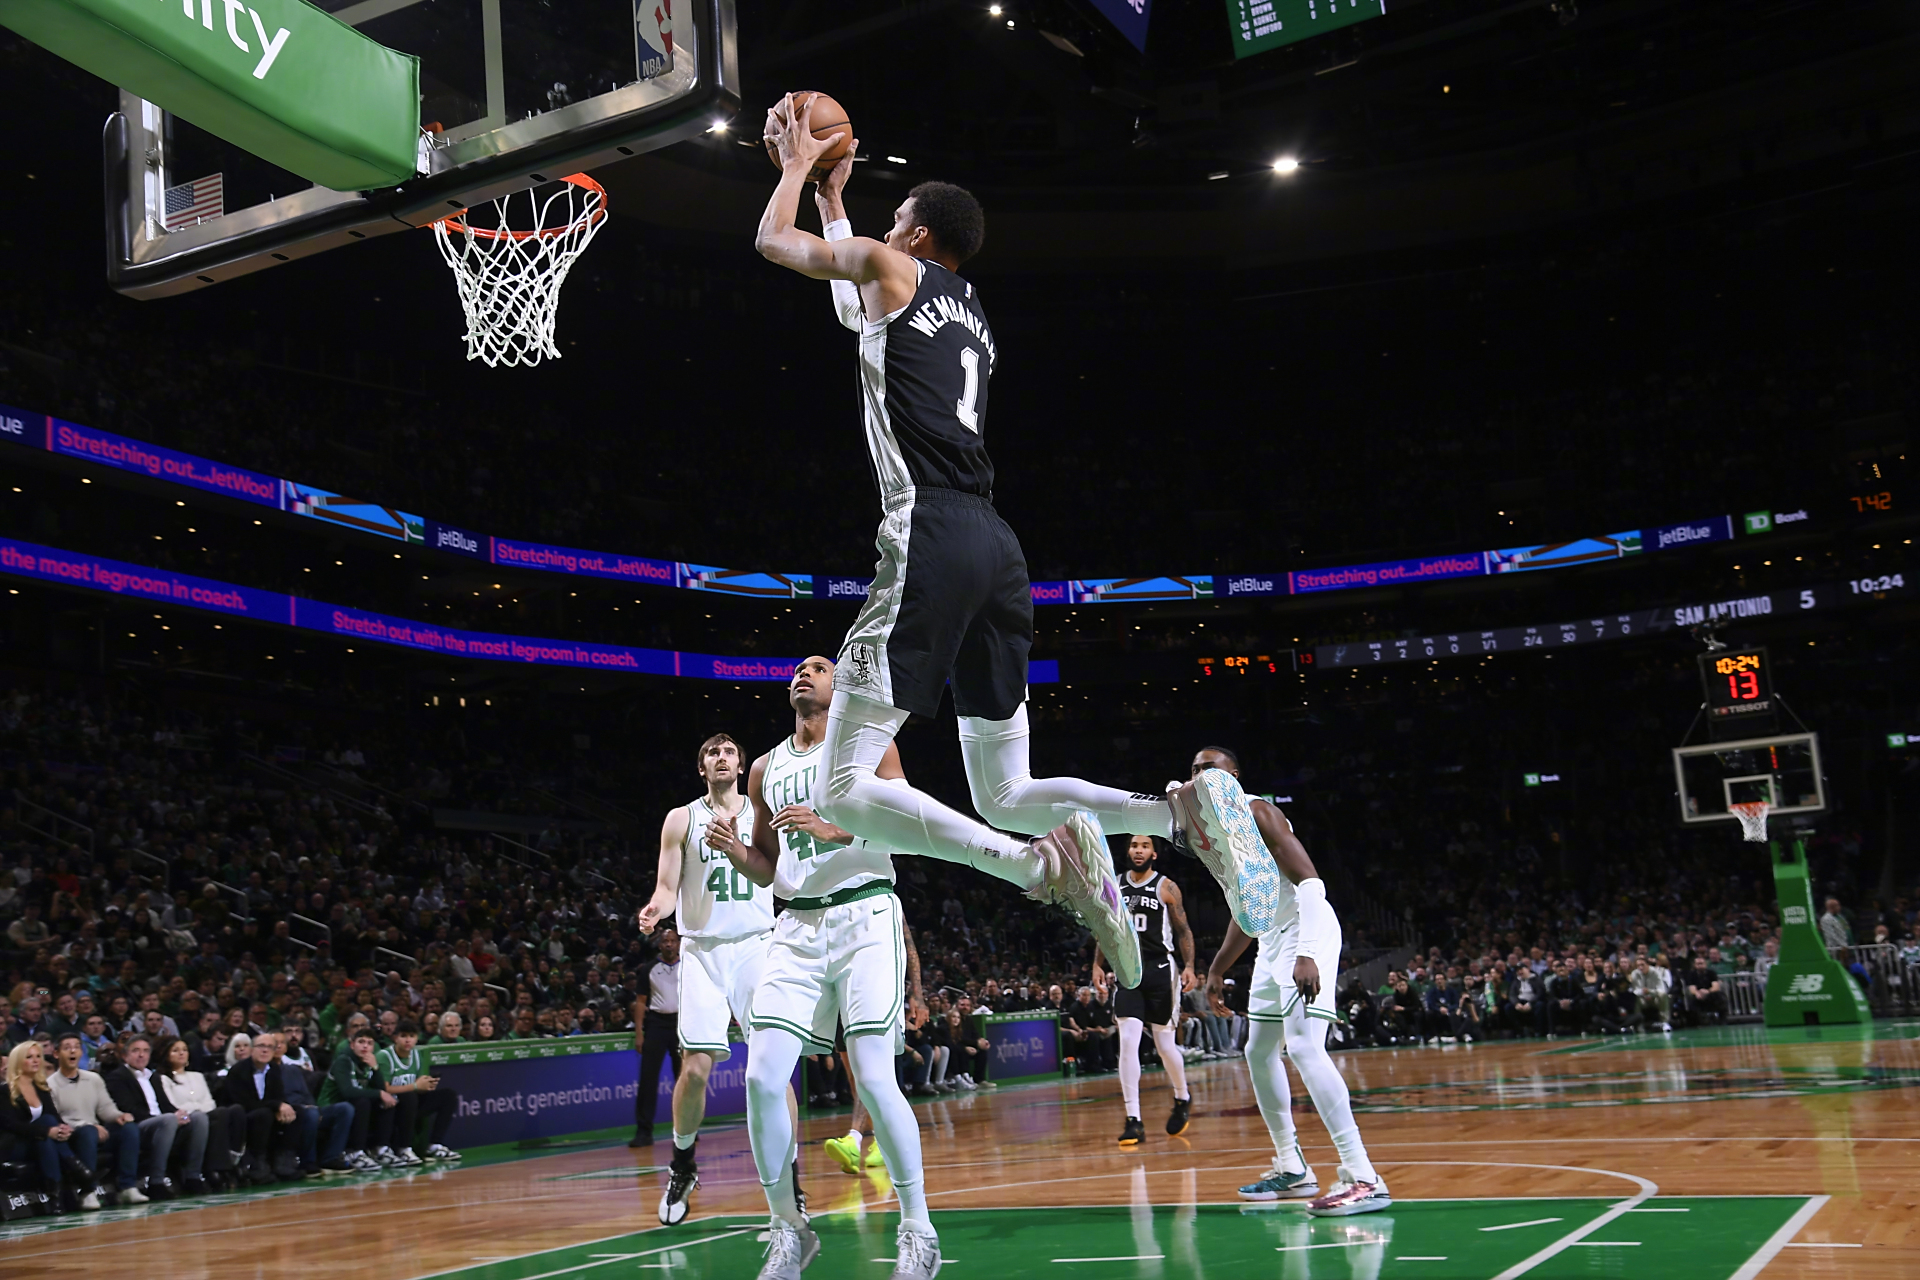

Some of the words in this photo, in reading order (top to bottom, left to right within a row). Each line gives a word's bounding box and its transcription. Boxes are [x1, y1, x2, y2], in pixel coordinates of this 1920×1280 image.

[1251, 2, 1273, 16] BROWN
[1253, 12, 1277, 27] KORNET
[1255, 21, 1283, 37] HORFORD
[642, 56, 661, 77] NBA
[908, 295, 996, 379] WEMBANYAM
[957, 346, 980, 435] 1
[59, 426, 160, 475] Stretching
[1747, 514, 1769, 530] TD
[1775, 510, 1808, 524] Bank
[438, 527, 478, 553] jetBlue
[1658, 525, 1711, 548] jetBlue
[497, 543, 577, 571] Stretching
[0, 547, 35, 570] the
[39, 557, 91, 581] most
[93, 564, 170, 596] legroom
[172, 579, 189, 599] in
[191, 588, 247, 610] coach.
[1228, 578, 1273, 595] jetBlue
[1297, 569, 1377, 588] Stretching
[1675, 605, 1704, 626] SAN
[1709, 596, 1772, 619] ANTONIO
[1800, 590, 1816, 609] 5
[1850, 573, 1904, 594] 10:24
[333, 611, 387, 638] Stretch
[389, 626, 412, 642] out
[413, 629, 443, 648] with
[444, 634, 466, 652] the
[469, 640, 509, 656] most
[512, 641, 574, 662] legroom
[576, 647, 590, 663] in
[591, 652, 639, 667] coach.
[1373, 651, 1381, 661] 3
[1399, 649, 1407, 658] 2
[1426, 646, 1434, 656] 0
[1450, 643, 1459, 653] 0
[1524, 636, 1543, 646] 2/4
[1562, 632, 1576, 642] 50
[1596, 628, 1604, 638] 7
[1621, 624, 1630, 634] 0
[713, 660, 767, 677] Stretch
[769, 664, 795, 677] out
[1300, 654, 1313, 664] 13
[1716, 655, 1760, 674] 10:24
[1728, 671, 1760, 699] 13
[1730, 701, 1769, 714] TISSOT
[773, 765, 817, 812] CELTI
[707, 866, 754, 902] 40
[996, 1038, 1028, 1063] xfinity
[706, 1062, 747, 1097] finit
[452, 1095, 481, 1118] he
[485, 1091, 523, 1114] next
[527, 1082, 611, 1117] generation
[615, 1076, 673, 1099] netrk
